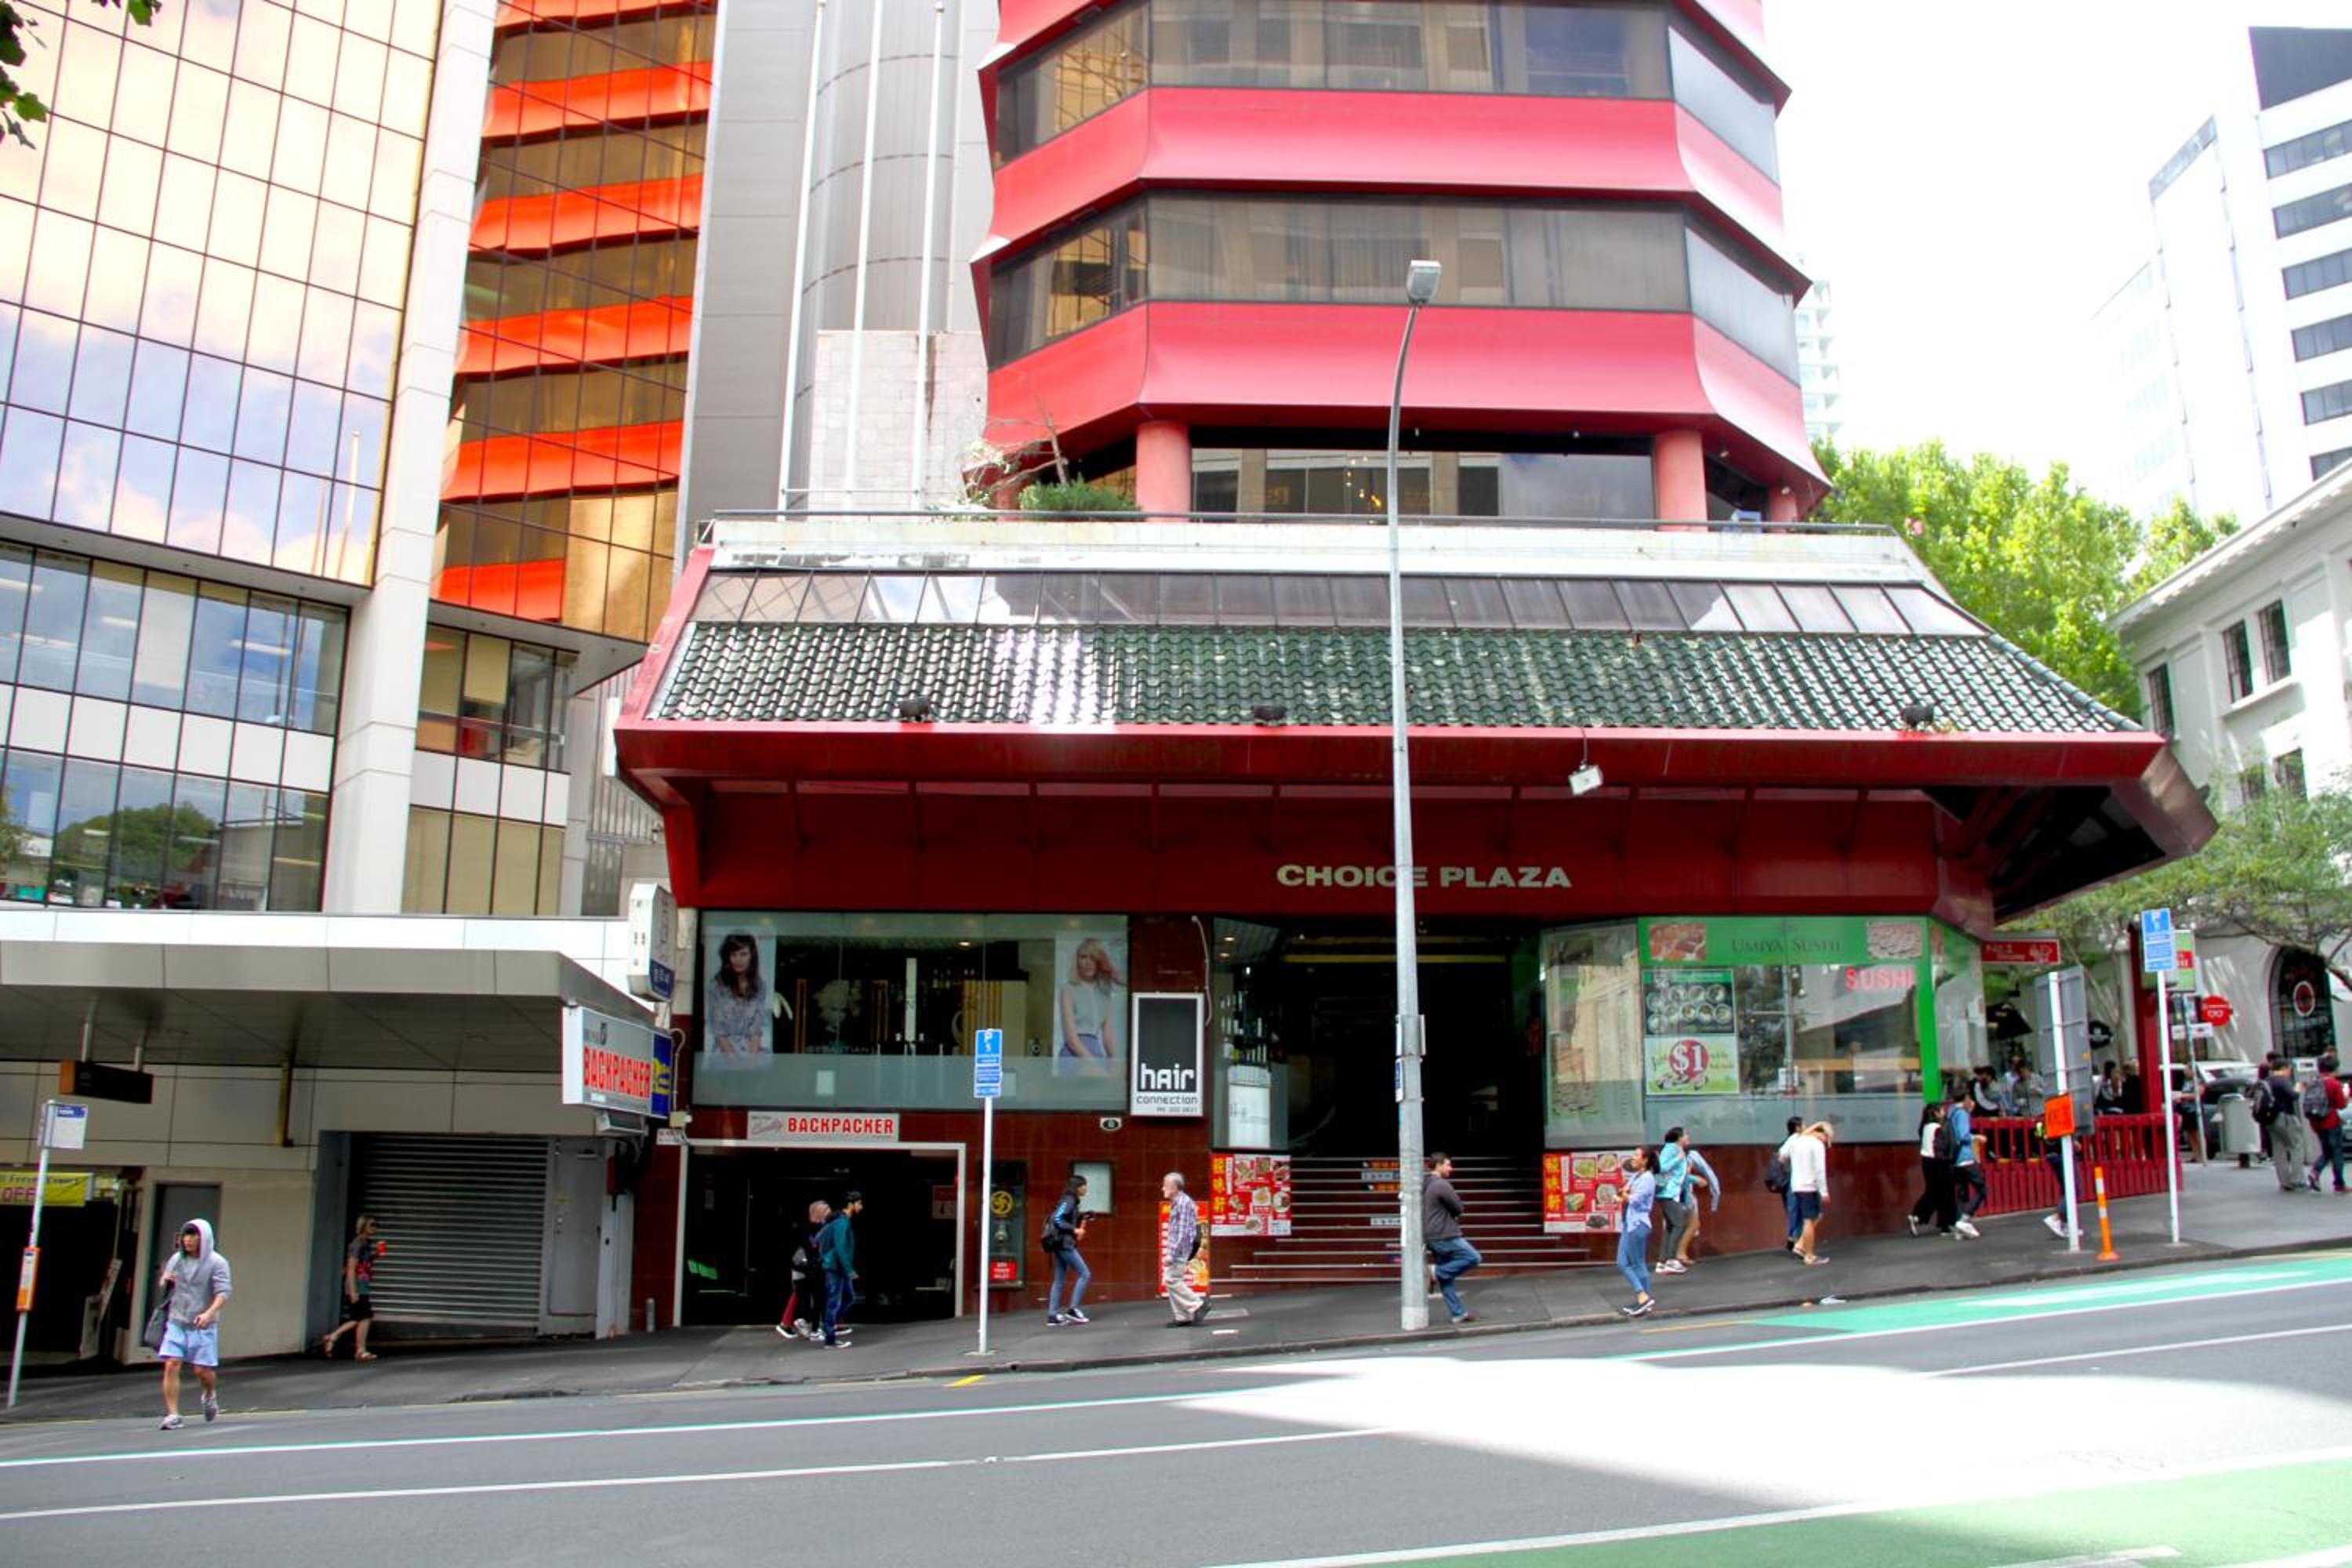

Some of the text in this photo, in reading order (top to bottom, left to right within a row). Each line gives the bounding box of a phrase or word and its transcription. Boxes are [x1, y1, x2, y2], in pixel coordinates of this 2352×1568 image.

[1276, 865, 1571, 887] CHOICE PLAZA
[1845, 967, 1914, 990] SUSHI
[1672, 1044, 1704, 1074] $1
[583, 1046, 652, 1099] BACKPACKER
[787, 1116, 894, 1134] BACKPACKER
